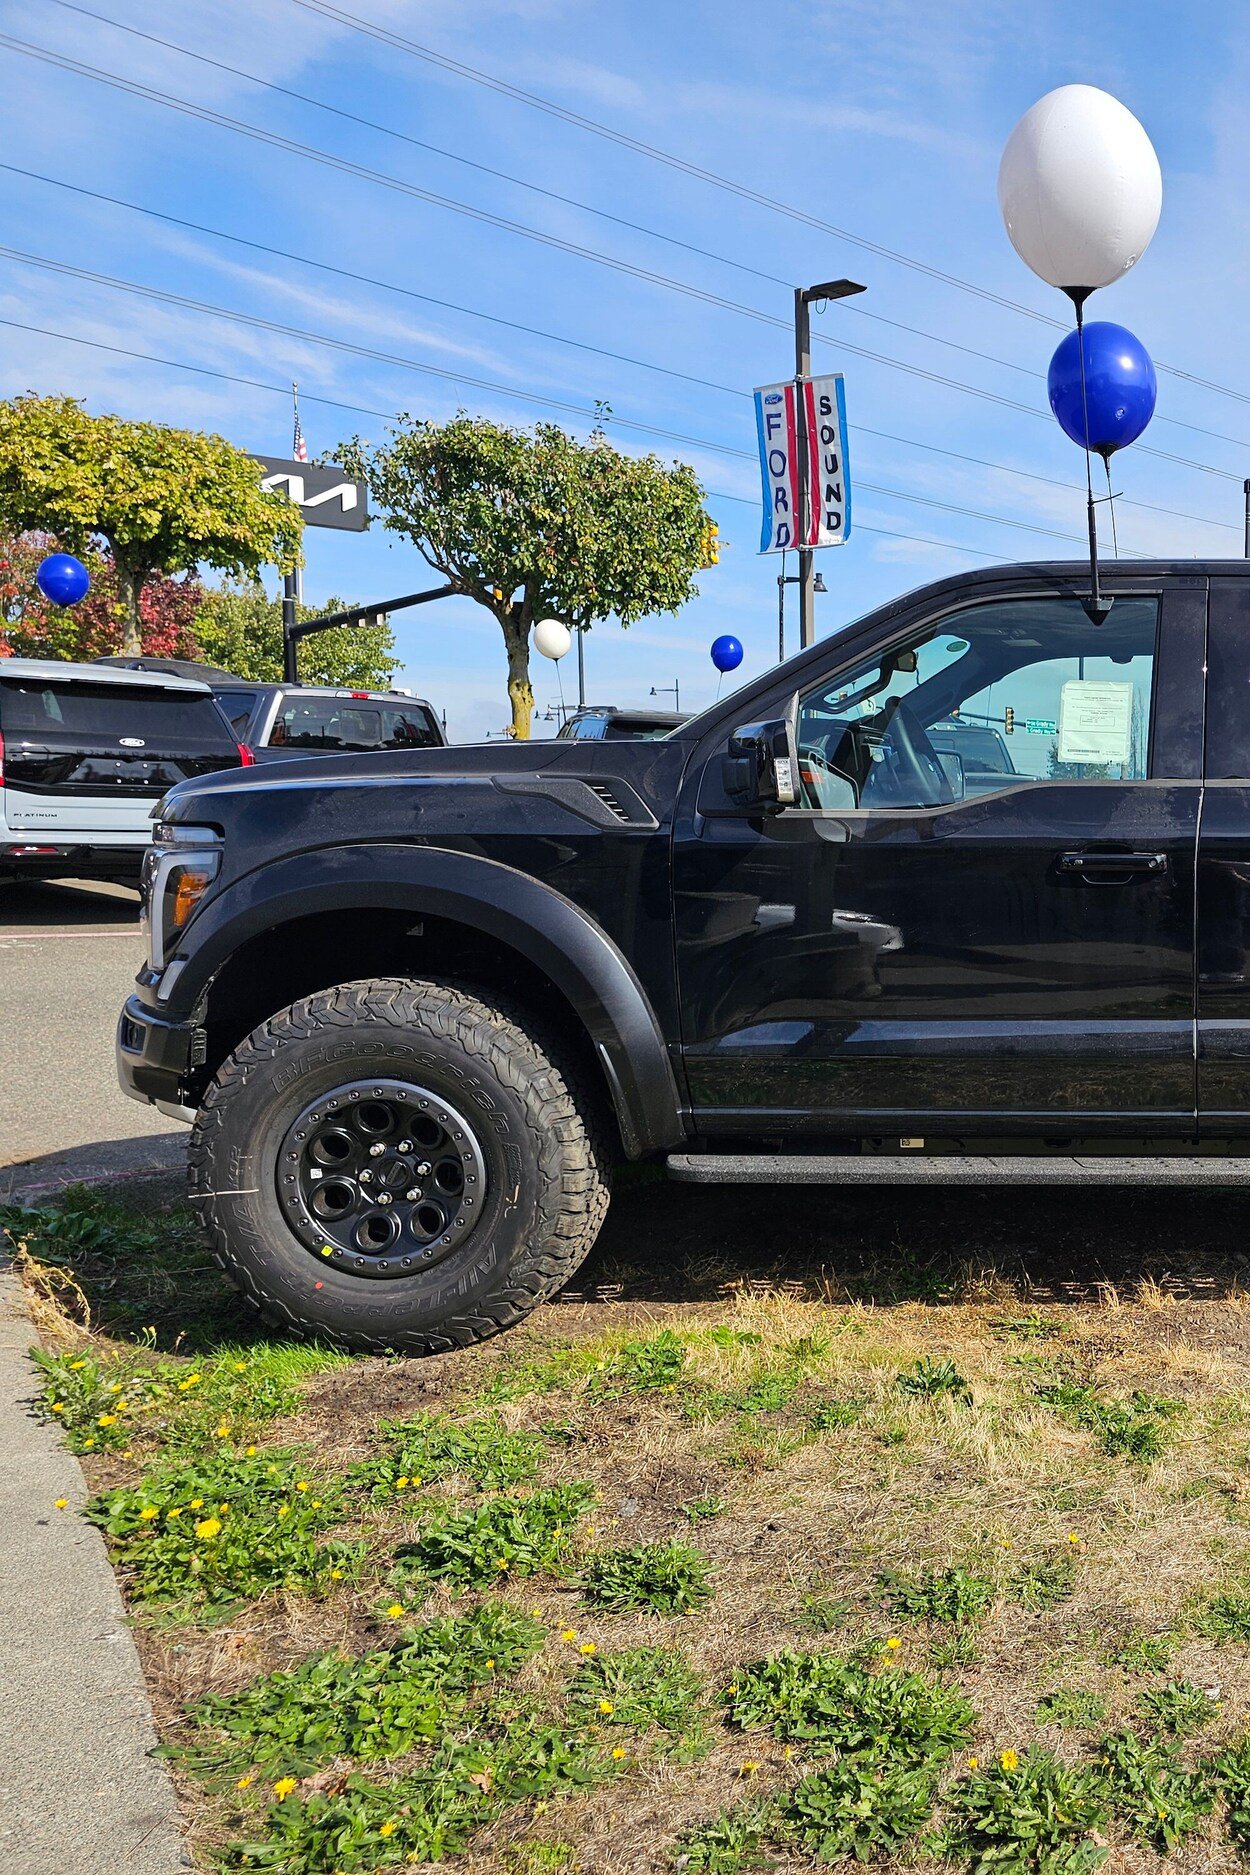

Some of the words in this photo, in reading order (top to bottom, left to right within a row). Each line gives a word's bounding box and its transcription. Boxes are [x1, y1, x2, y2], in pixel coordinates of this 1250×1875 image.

[765, 395, 783, 404] Ford
[766, 412, 791, 548] FORD
[819, 395, 842, 531] SOUND
[271, 1039, 510, 1134] BFGoodrich
